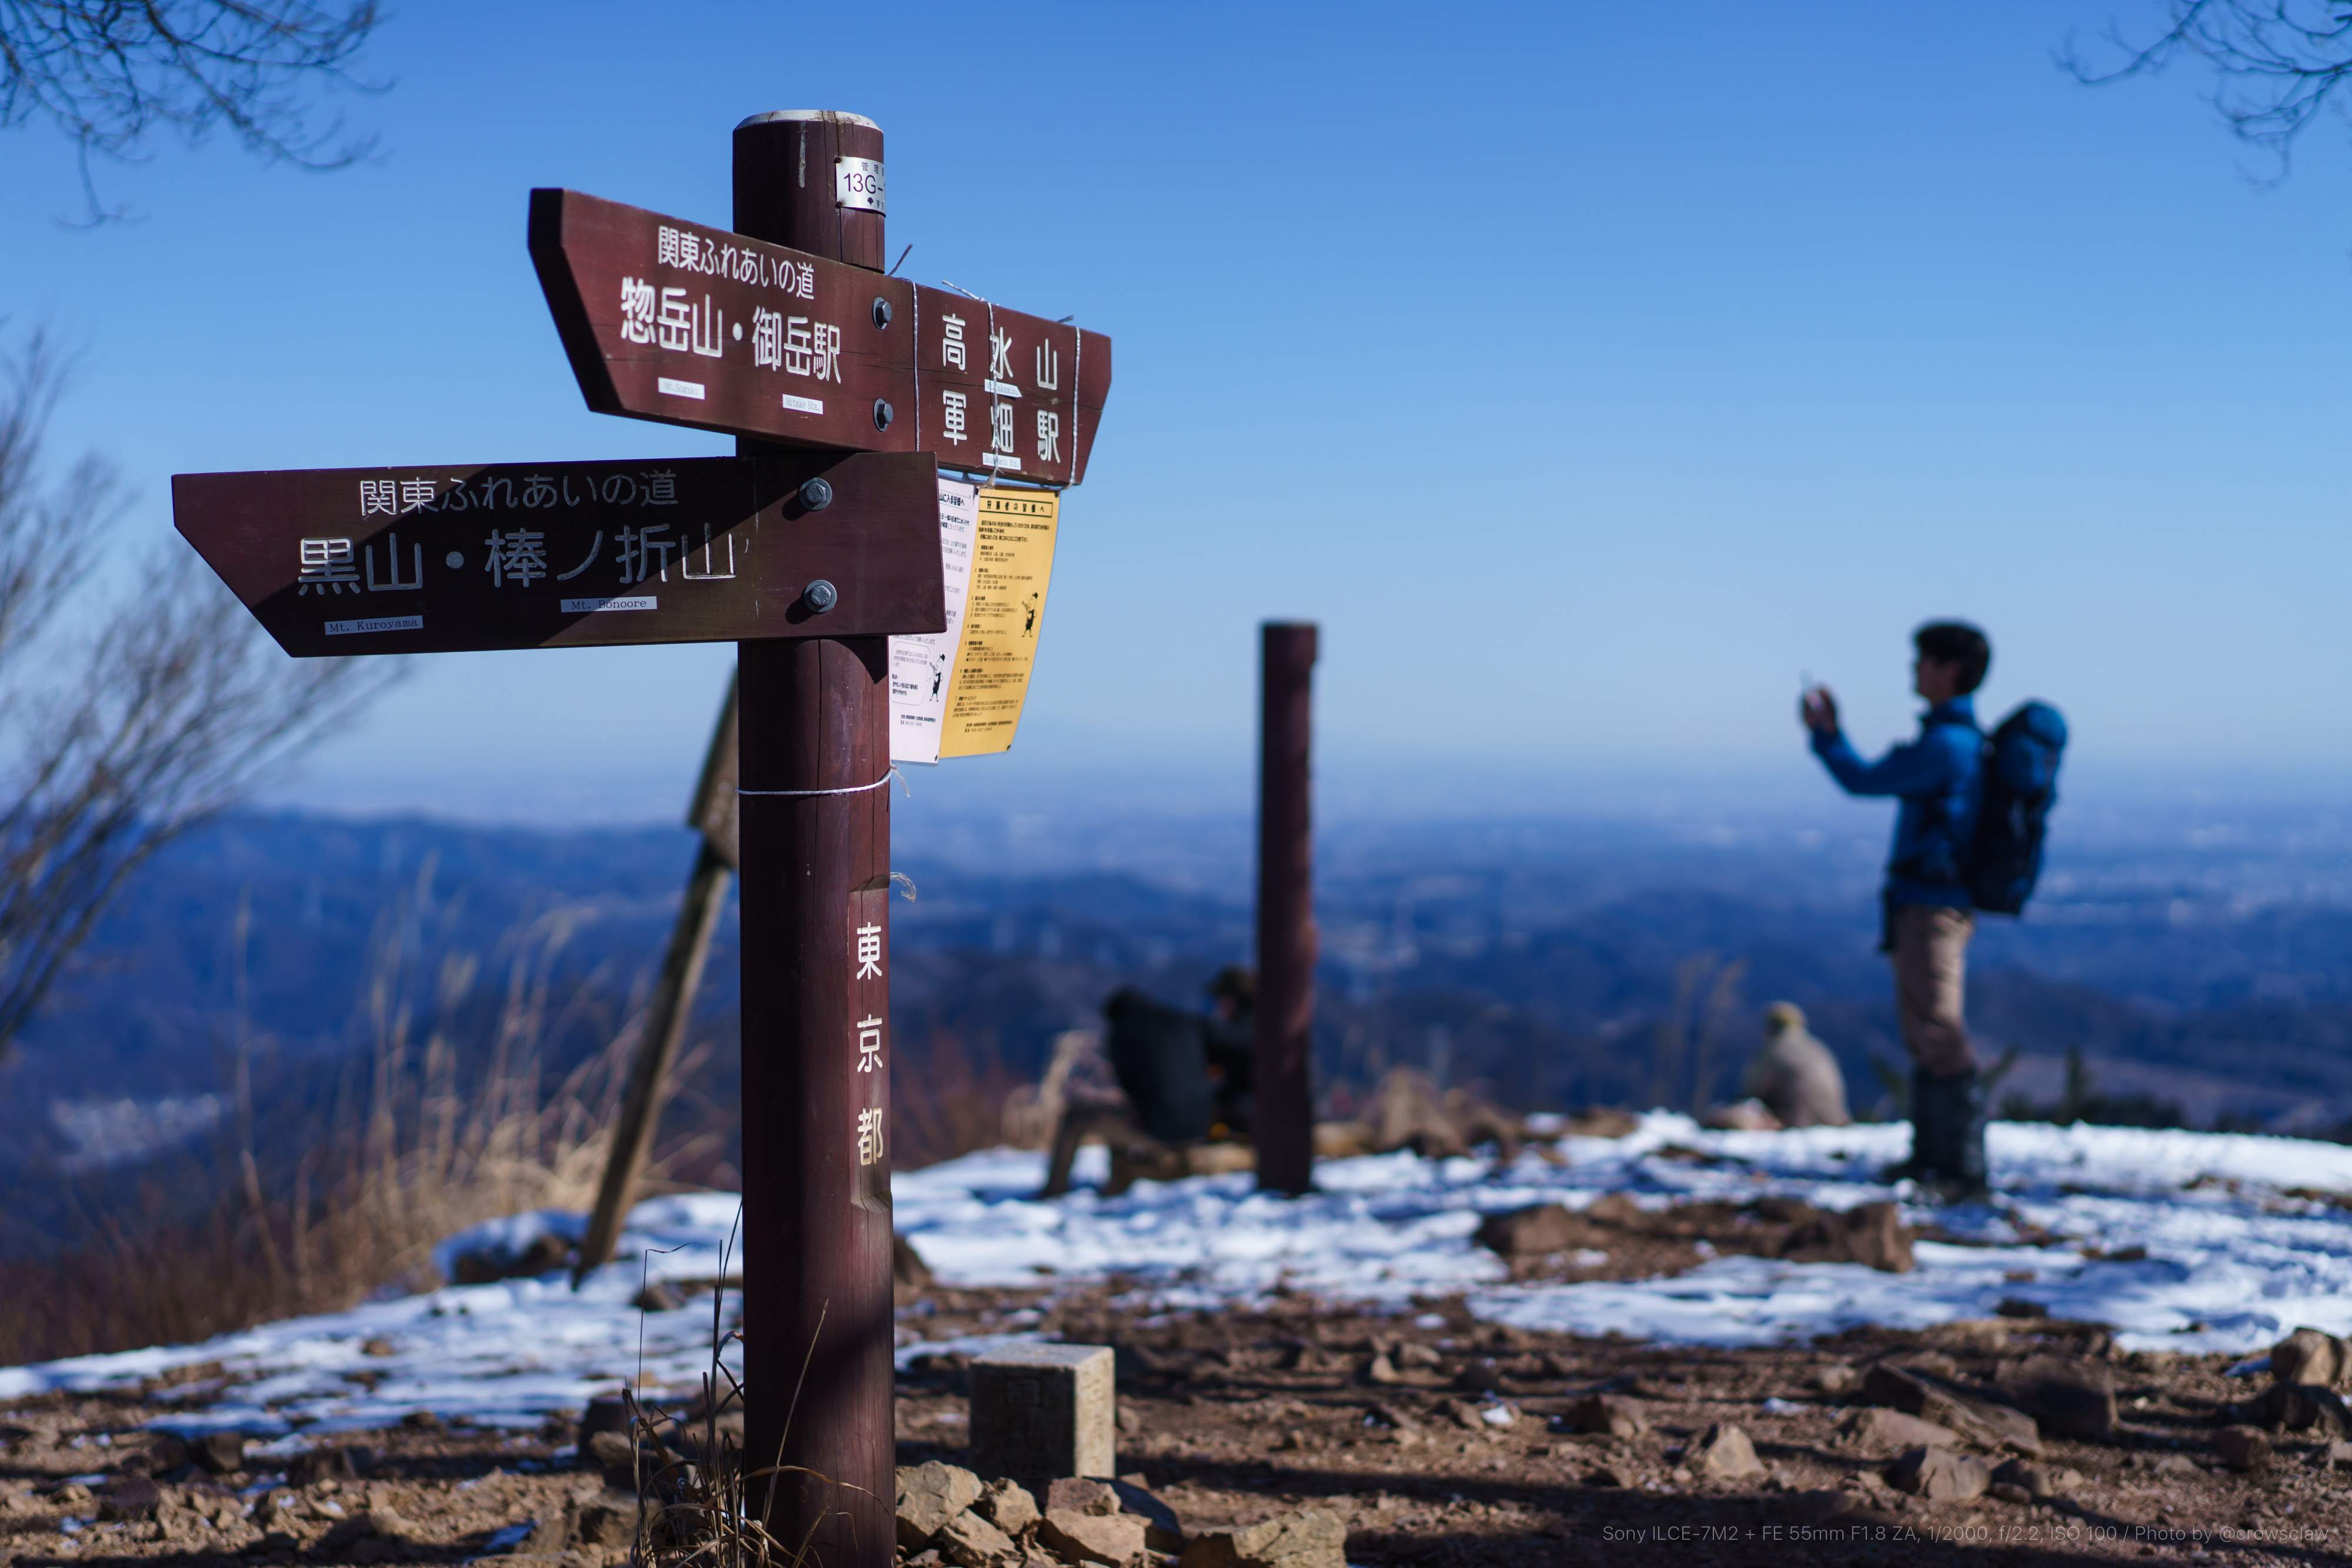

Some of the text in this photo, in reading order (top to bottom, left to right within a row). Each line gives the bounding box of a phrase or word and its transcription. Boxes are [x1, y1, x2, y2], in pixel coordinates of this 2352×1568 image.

[844, 173, 885, 194] 13G-
[658, 225, 814, 300] 関東ふれあいの道
[620, 277, 841, 384] 惣岳山・御岳駅
[786, 397, 820, 411] Mitake Sta.
[360, 469, 678, 516] 関東ふれあいの道
[298, 523, 736, 596] 黒山・棒ノ折山
[329, 618, 419, 633] Mt. Kuroyama
[572, 599, 647, 610] Mt. Bonoore
[857, 922, 882, 1166] 東京都
